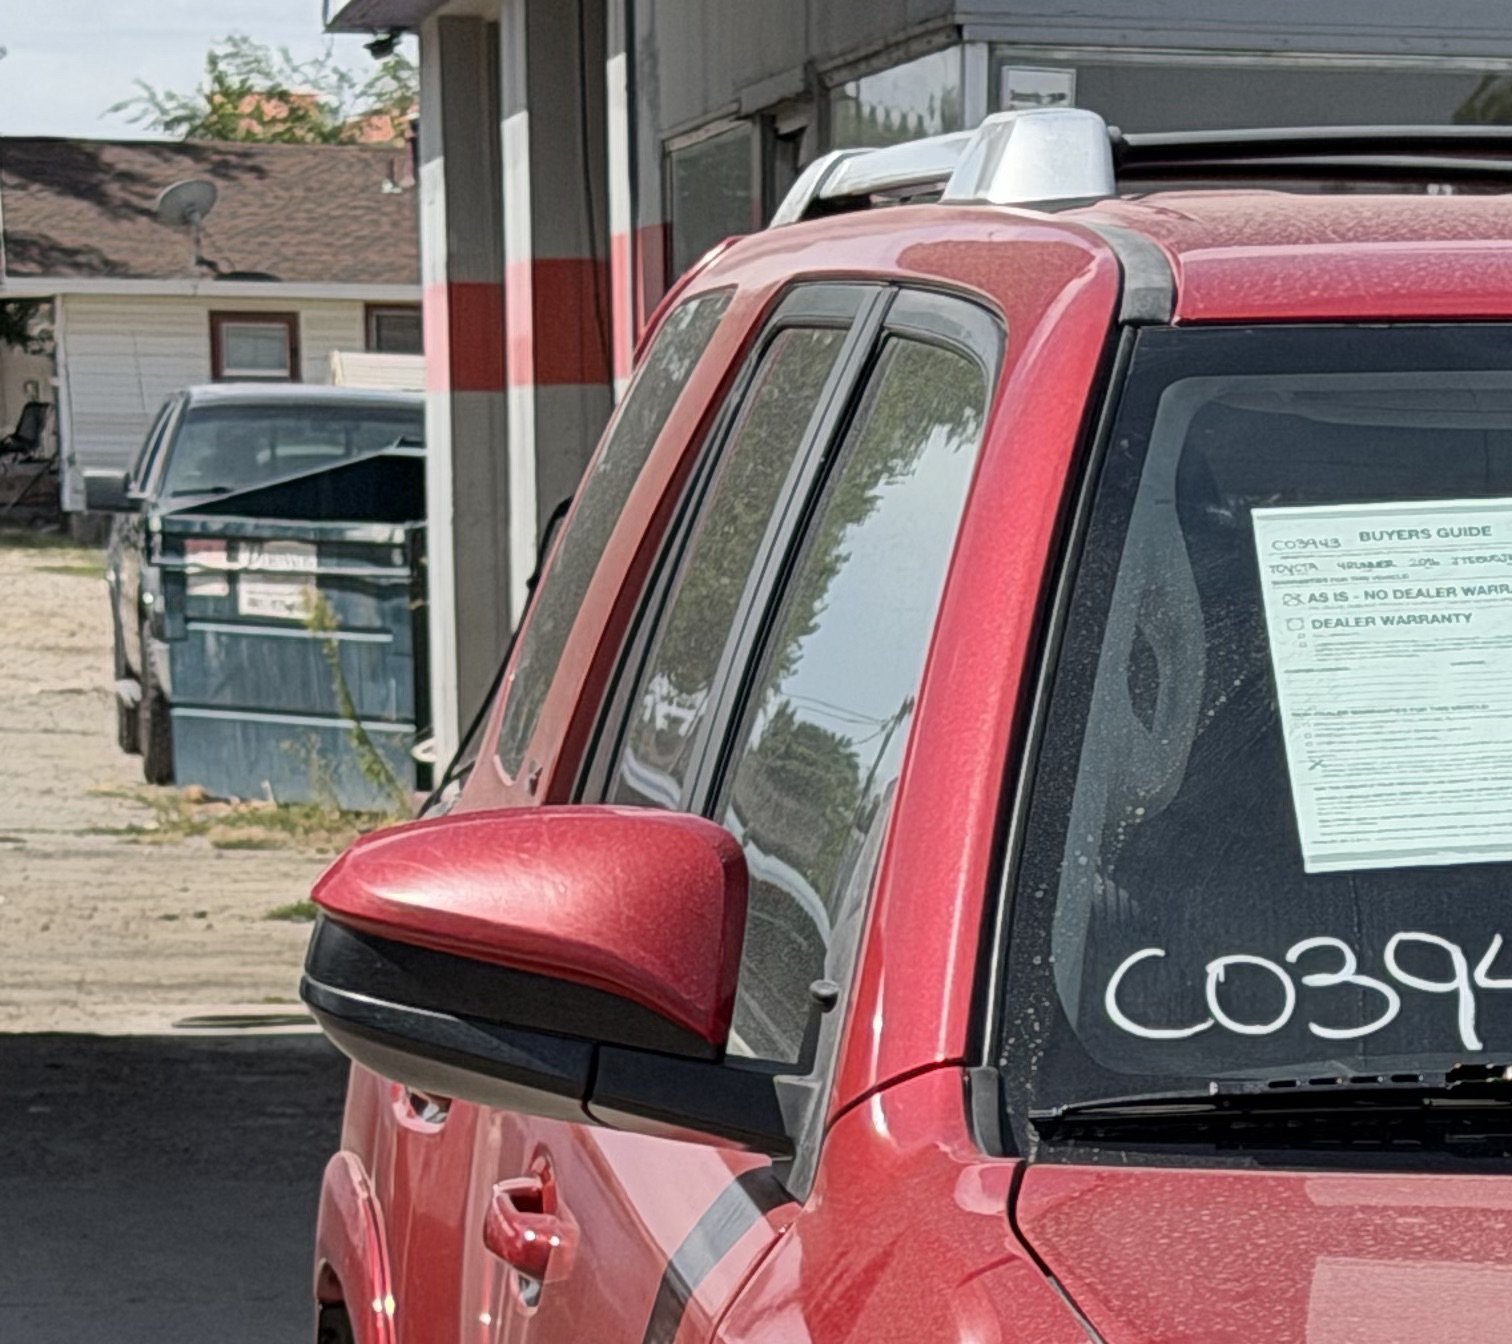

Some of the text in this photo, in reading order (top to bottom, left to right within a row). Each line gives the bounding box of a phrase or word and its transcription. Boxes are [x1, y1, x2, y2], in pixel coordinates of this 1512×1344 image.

[1359, 525, 1492, 542] BUYERS GUIDE
[1308, 591, 1329, 603] AS
[1333, 591, 1349, 602] IS
[1364, 589, 1388, 601] NO
[1392, 585, 1457, 600] DEALER
[1311, 613, 1473, 629] DEALER WARRANTY
